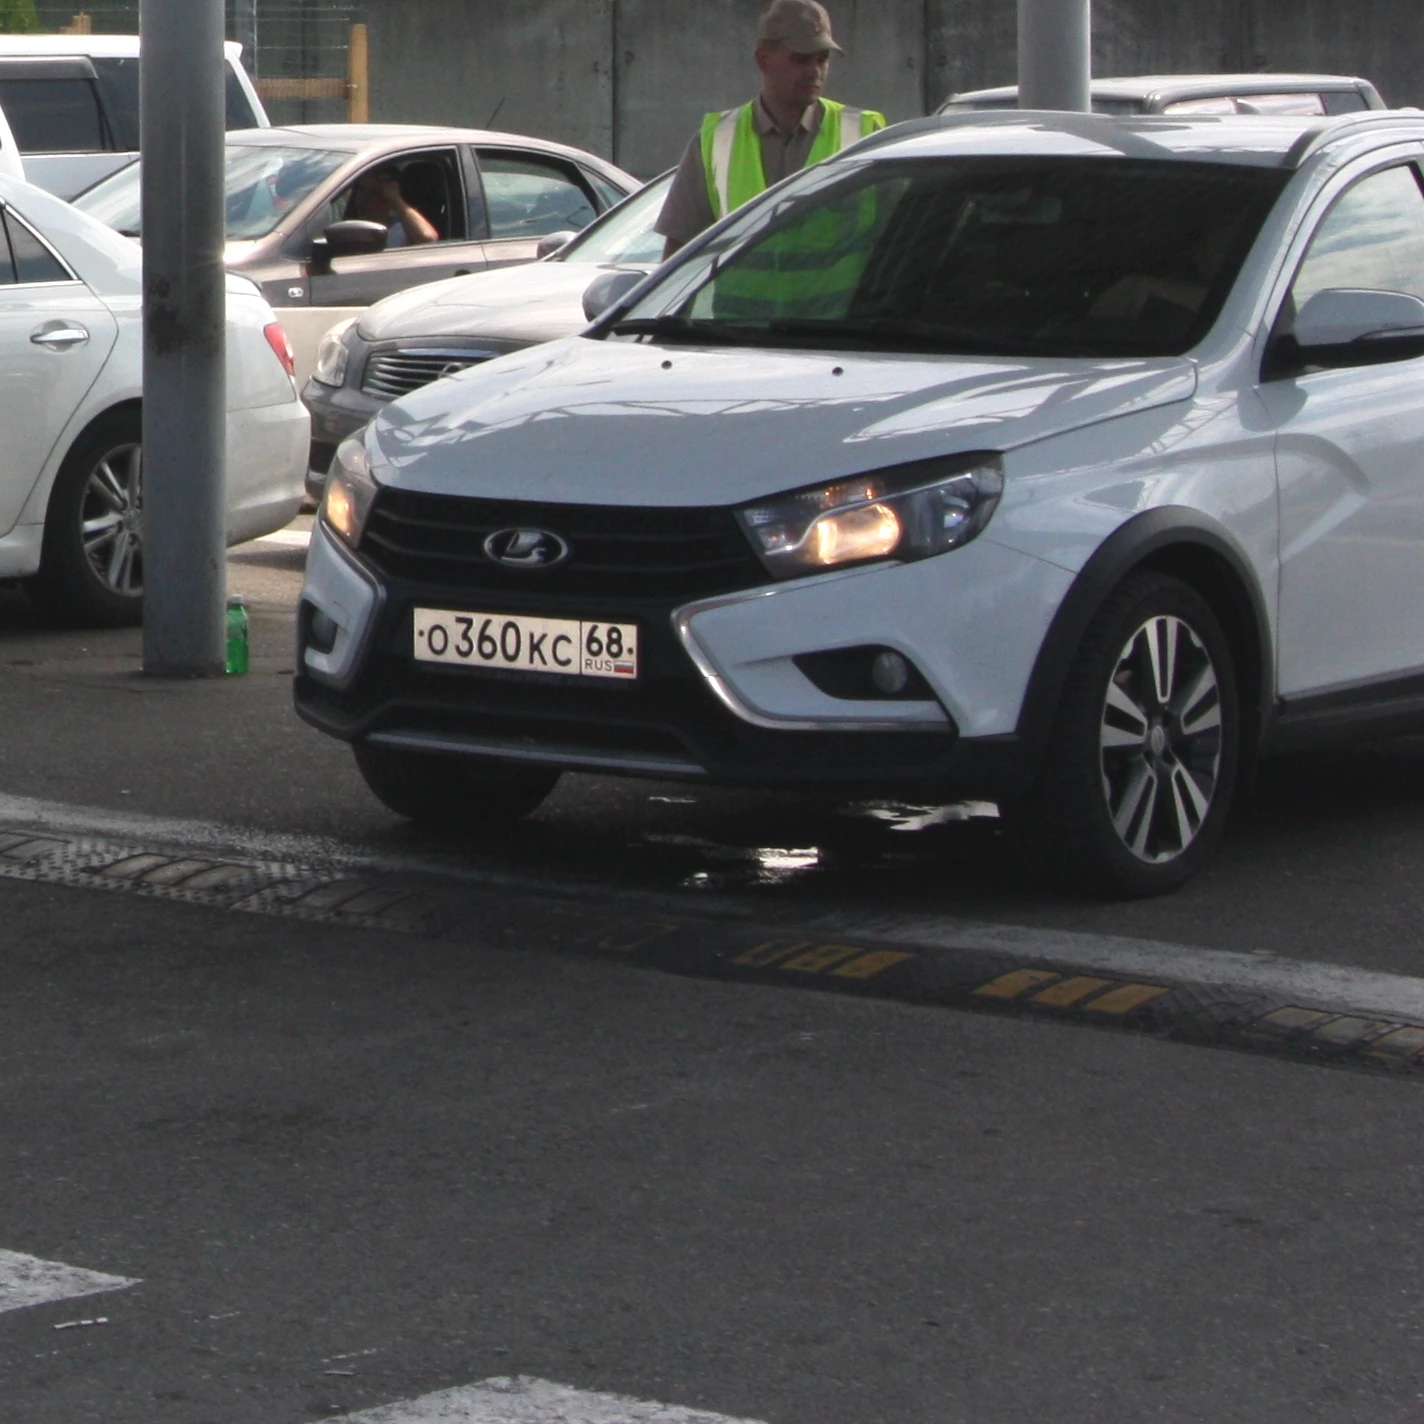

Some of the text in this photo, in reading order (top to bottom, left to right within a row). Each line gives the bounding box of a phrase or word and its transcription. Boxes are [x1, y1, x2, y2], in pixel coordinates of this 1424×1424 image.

[426, 615, 625, 667] О360КС 68
[584, 658, 613, 672] RUS
